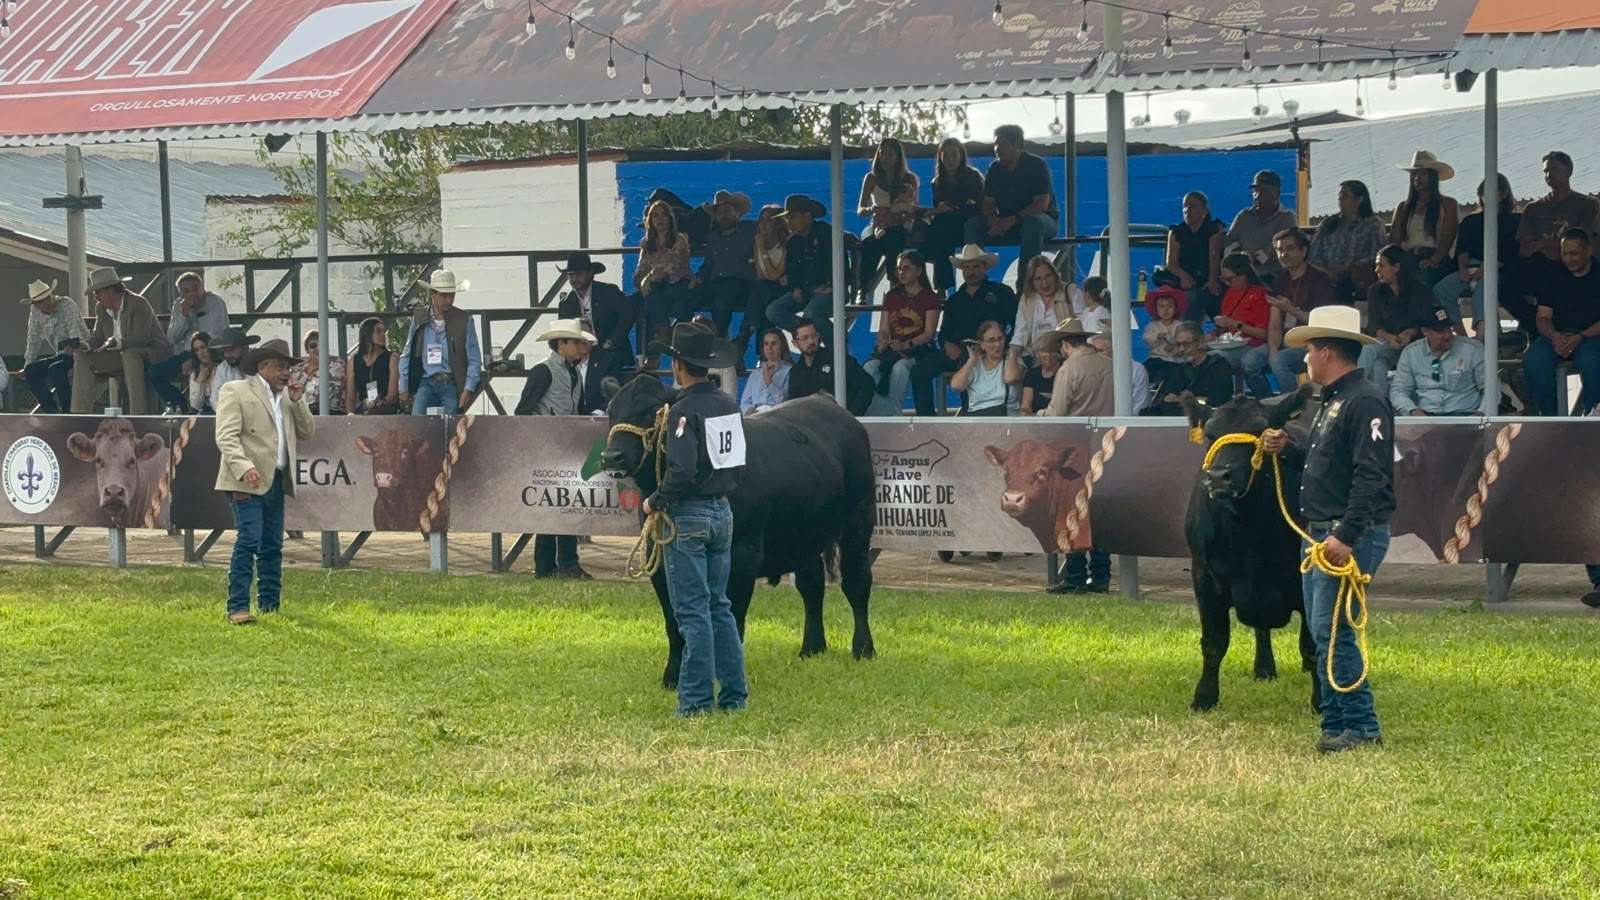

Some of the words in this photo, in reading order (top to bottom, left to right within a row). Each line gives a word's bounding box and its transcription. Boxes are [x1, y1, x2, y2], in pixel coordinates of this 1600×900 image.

[90, 94, 246, 113] ORGULLOSAMENTE
[247, 87, 343, 104] NORTEÑOS
[719, 430, 732, 454] 18
[296, 458, 357, 486] EGA.
[891, 455, 930, 468] Angus
[875, 485, 932, 504] GRANDE
[936, 485, 955, 505] DE
[873, 507, 948, 528] IHUAHUA
